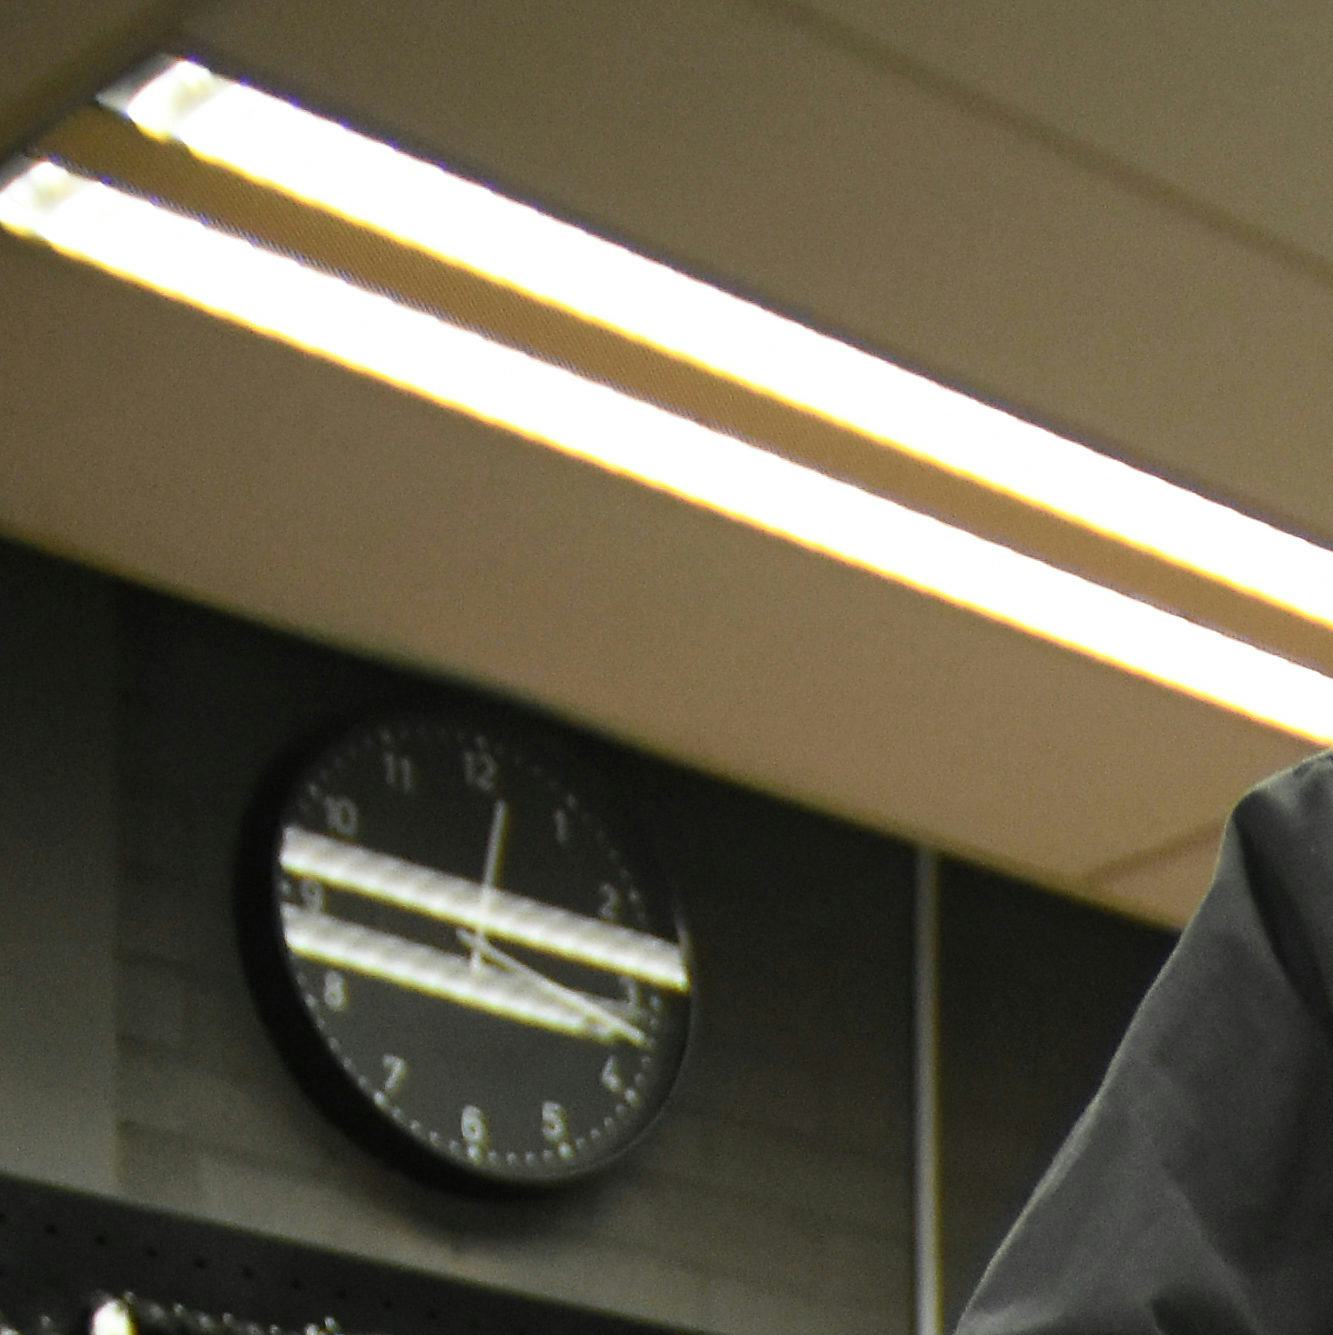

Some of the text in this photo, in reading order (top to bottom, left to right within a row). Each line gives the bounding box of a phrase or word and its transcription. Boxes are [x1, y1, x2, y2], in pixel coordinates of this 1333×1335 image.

[382, 752, 414, 795] 11
[463, 751, 498, 791] 12
[323, 797, 358, 837] 10
[596, 884, 620, 921] 2
[322, 973, 348, 1012] 8
[382, 1053, 409, 1093] 7
[600, 1059, 621, 1093] 4
[460, 1104, 487, 1144] 6
[541, 1100, 569, 1144] 5
